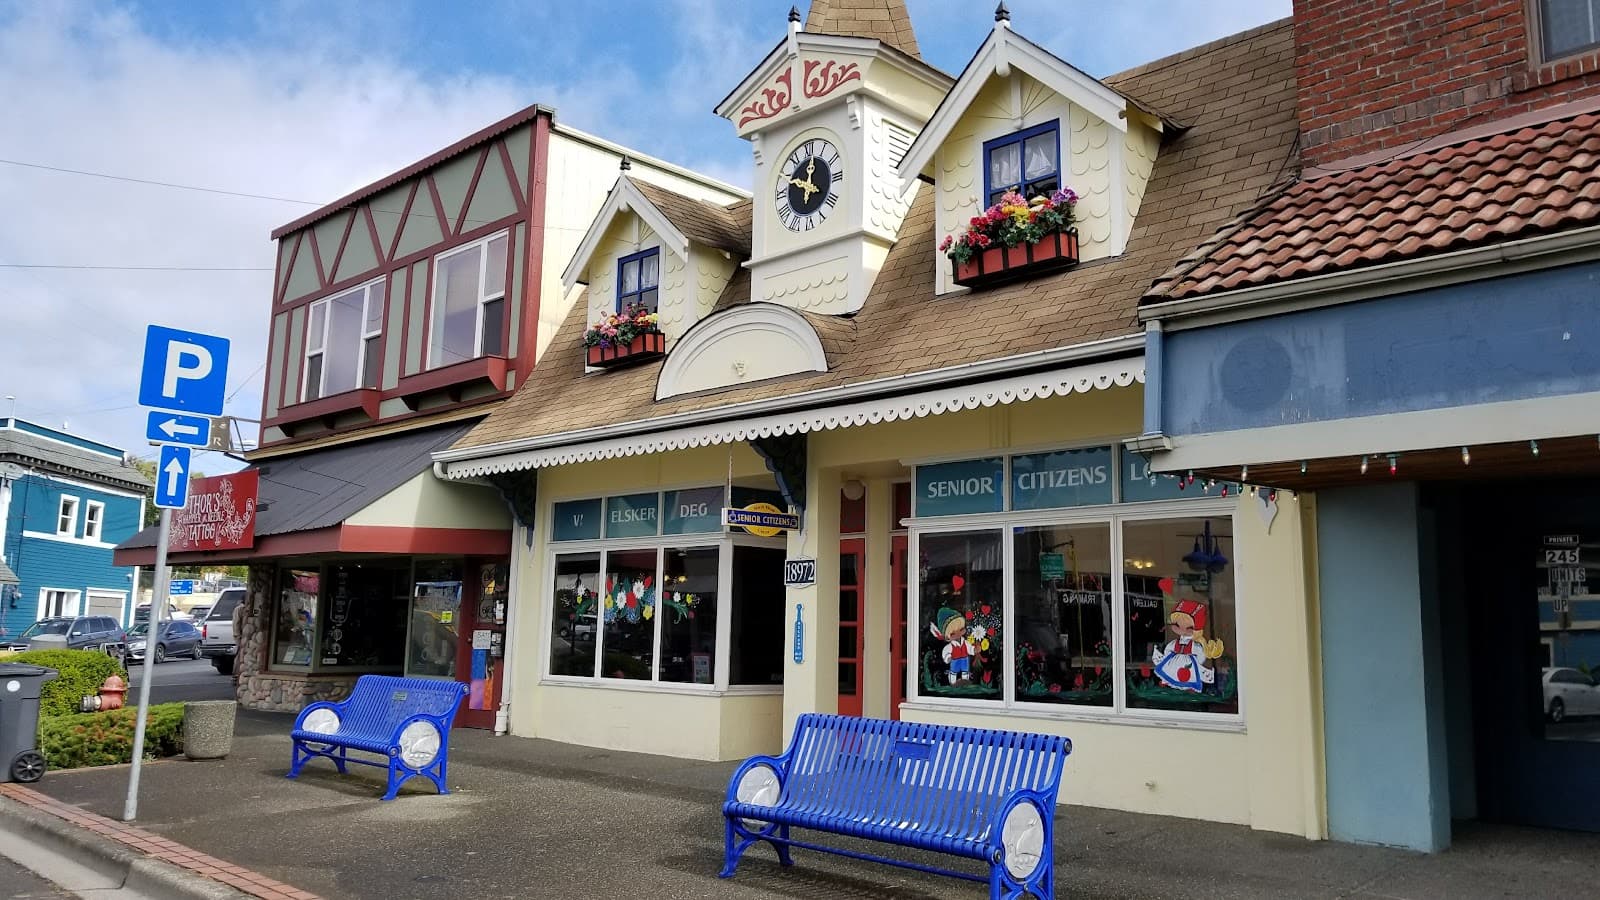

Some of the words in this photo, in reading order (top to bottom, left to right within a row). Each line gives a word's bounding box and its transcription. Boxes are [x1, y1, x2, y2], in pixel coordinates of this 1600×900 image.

[162, 340, 213, 398] P
[927, 476, 995, 499] SENIOR
[1018, 465, 1107, 490] CITIZENS
[189, 492, 221, 514] THOR'S
[611, 507, 657, 523] ELSKER
[680, 502, 708, 518] DEG
[737, 513, 761, 524] SENIOR
[762, 515, 791, 526] CITIZENS
[188, 523, 216, 546] TATTOO
[1547, 551, 1577, 563] 245
[786, 562, 814, 582] 18972
[1552, 567, 1585, 581] UNITS
[1554, 599, 1567, 611] UP
